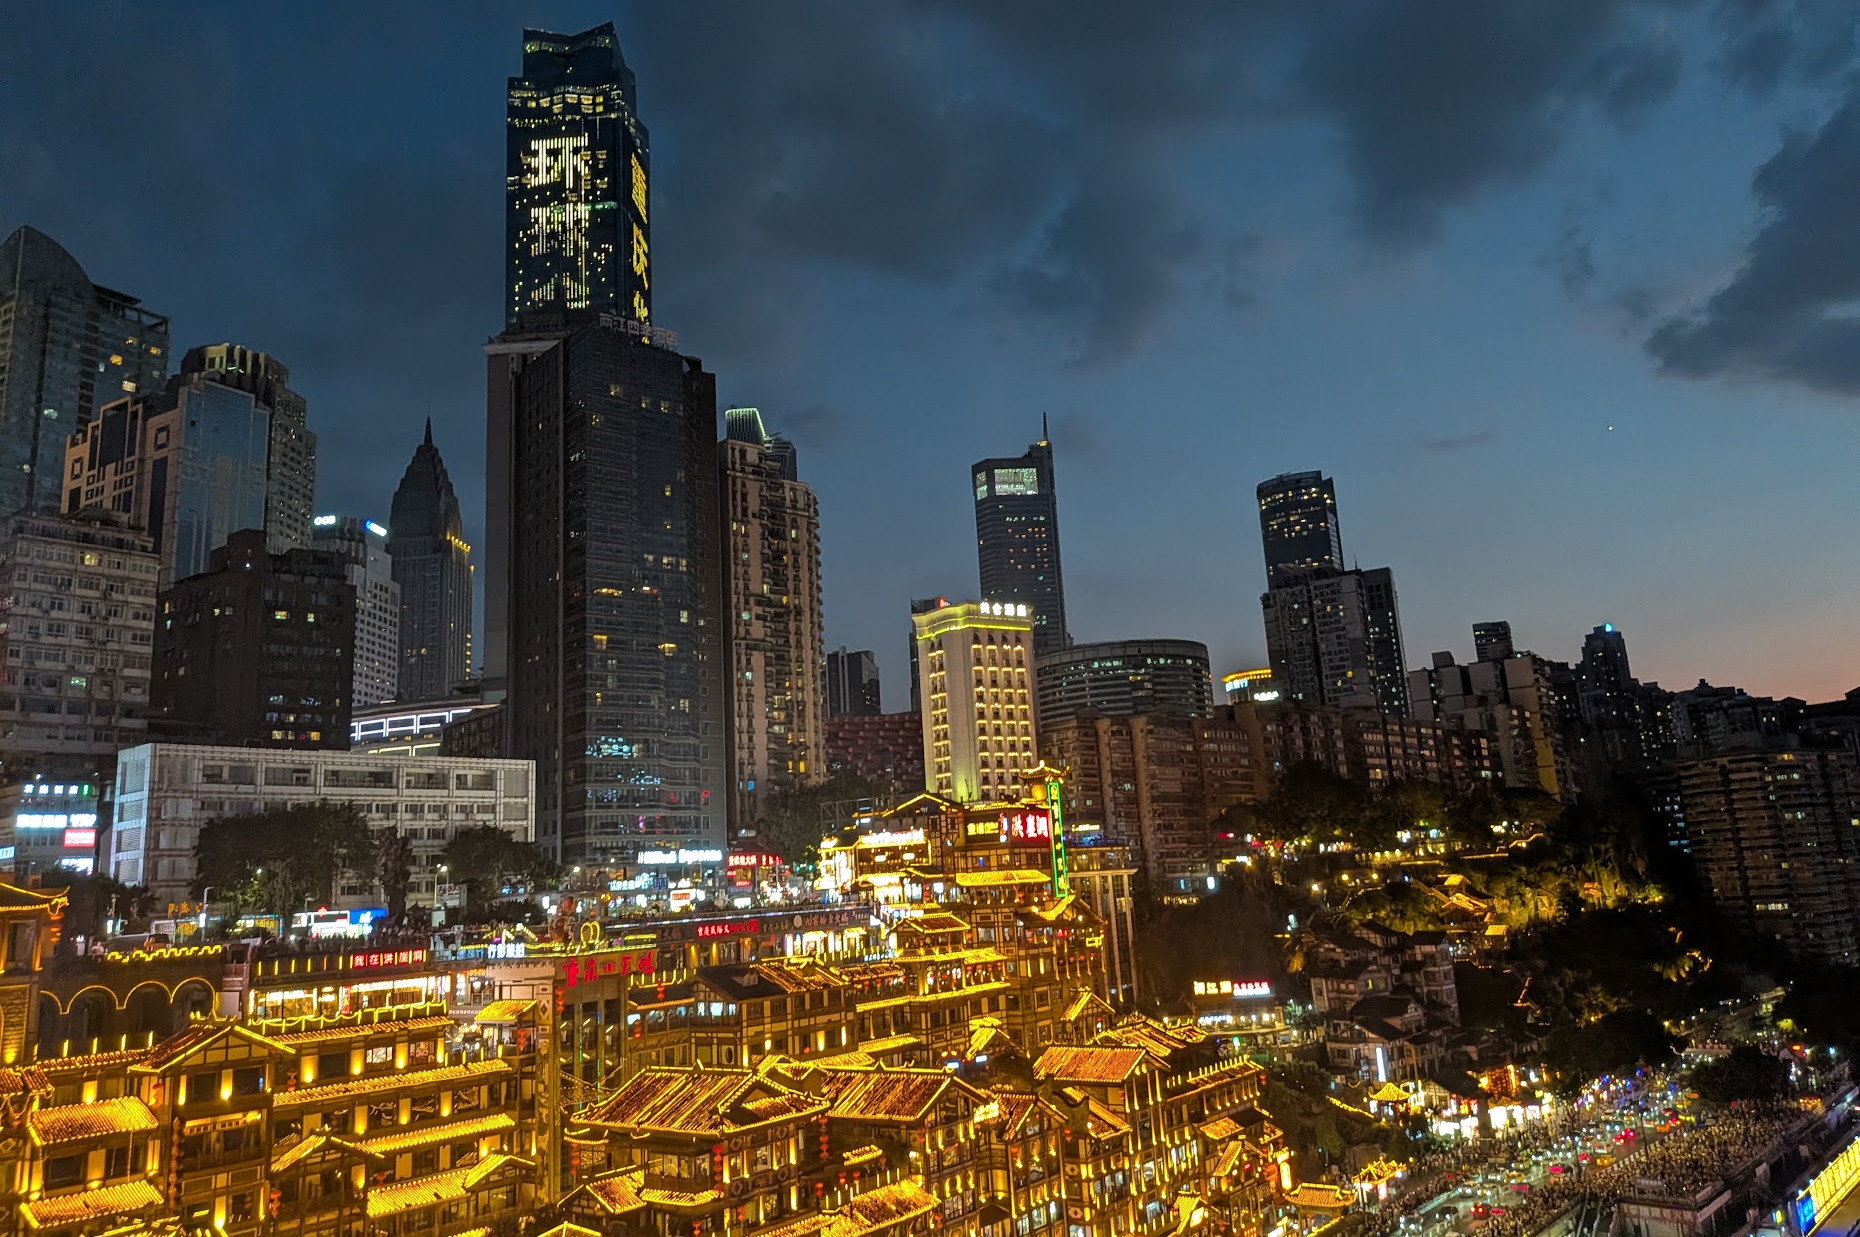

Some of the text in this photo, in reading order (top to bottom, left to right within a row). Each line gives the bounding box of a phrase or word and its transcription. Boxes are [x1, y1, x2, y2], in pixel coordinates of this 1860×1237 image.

[354, 949, 423, 967] 我在洪崖洞
